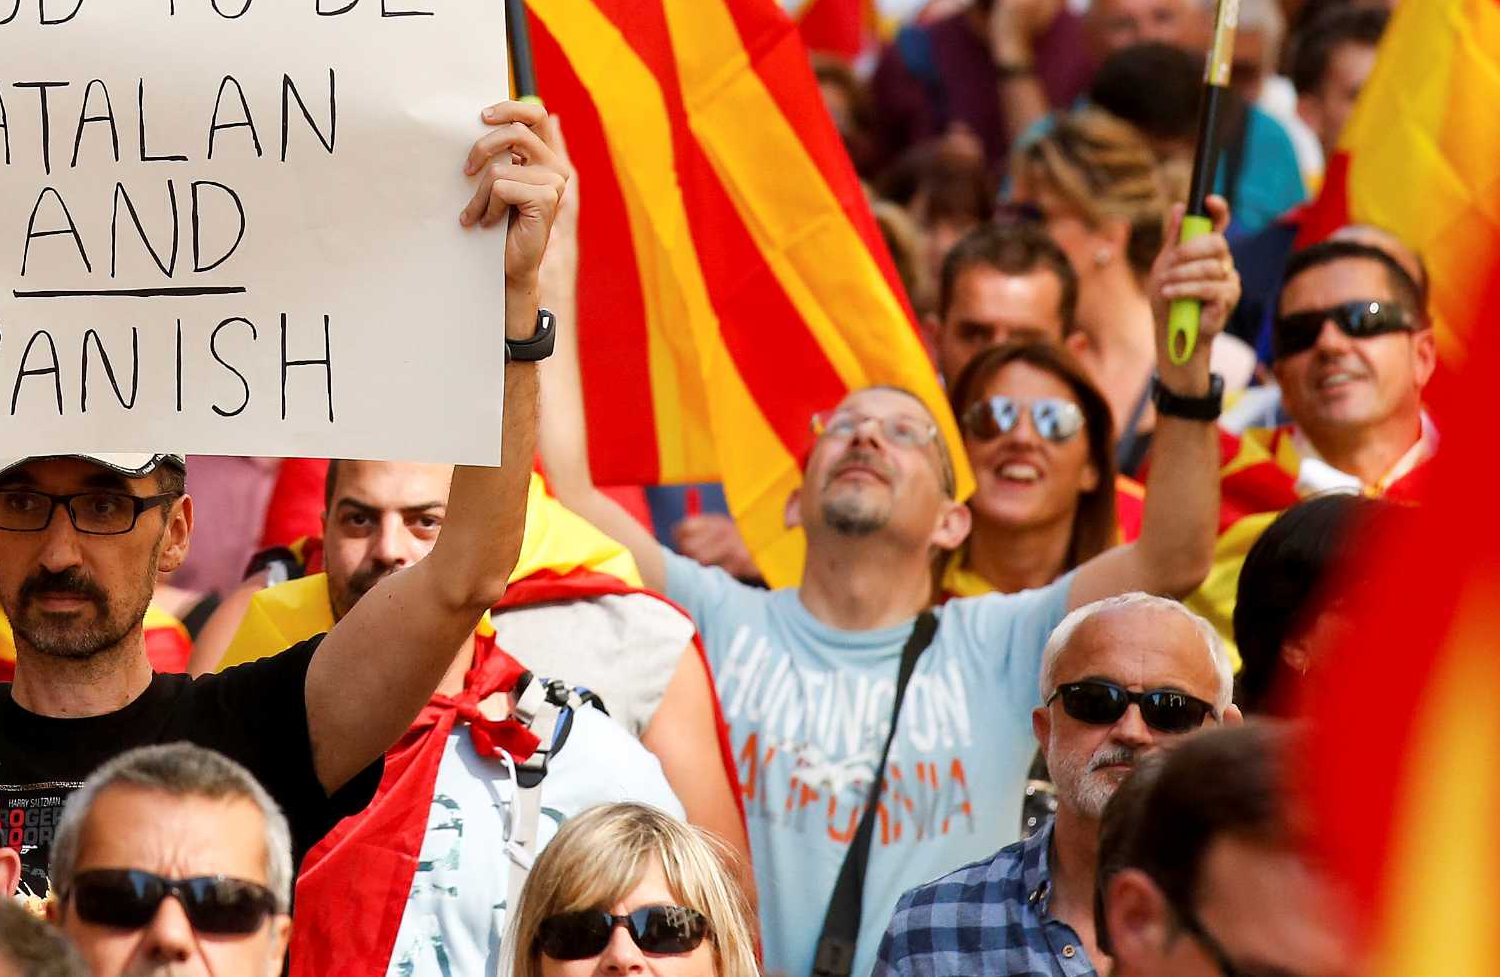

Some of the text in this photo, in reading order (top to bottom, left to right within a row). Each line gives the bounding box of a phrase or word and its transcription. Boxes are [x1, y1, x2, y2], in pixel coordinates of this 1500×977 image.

[20, 179, 246, 279] AND
[716, 623, 974, 761] HUNTINGON
[8, 796, 61, 809] HARRY SALTZMAN
[737, 731, 975, 849] ALIFORNIA
